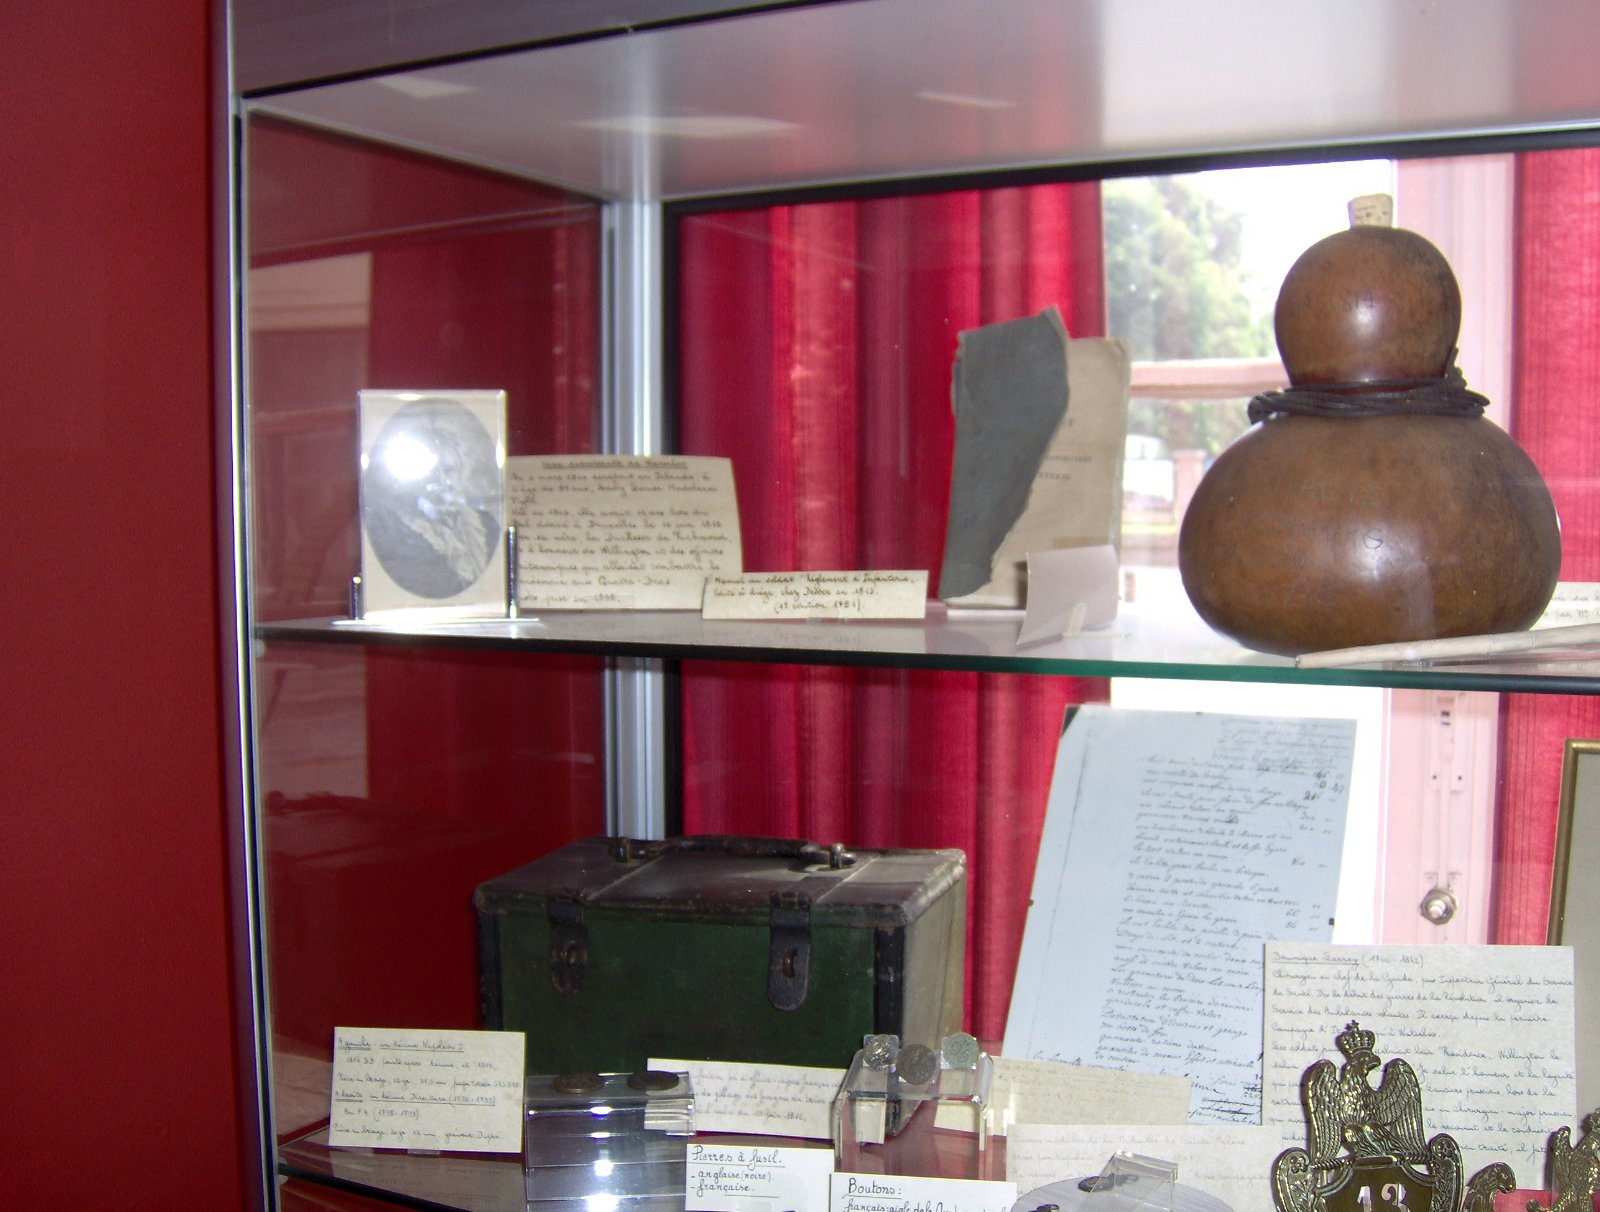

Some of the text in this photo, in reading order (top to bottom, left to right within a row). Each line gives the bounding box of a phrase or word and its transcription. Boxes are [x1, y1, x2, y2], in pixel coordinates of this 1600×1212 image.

[691, 1145, 782, 1172] Pierres à fusil.
[696, 1178, 755, 1198] française.
